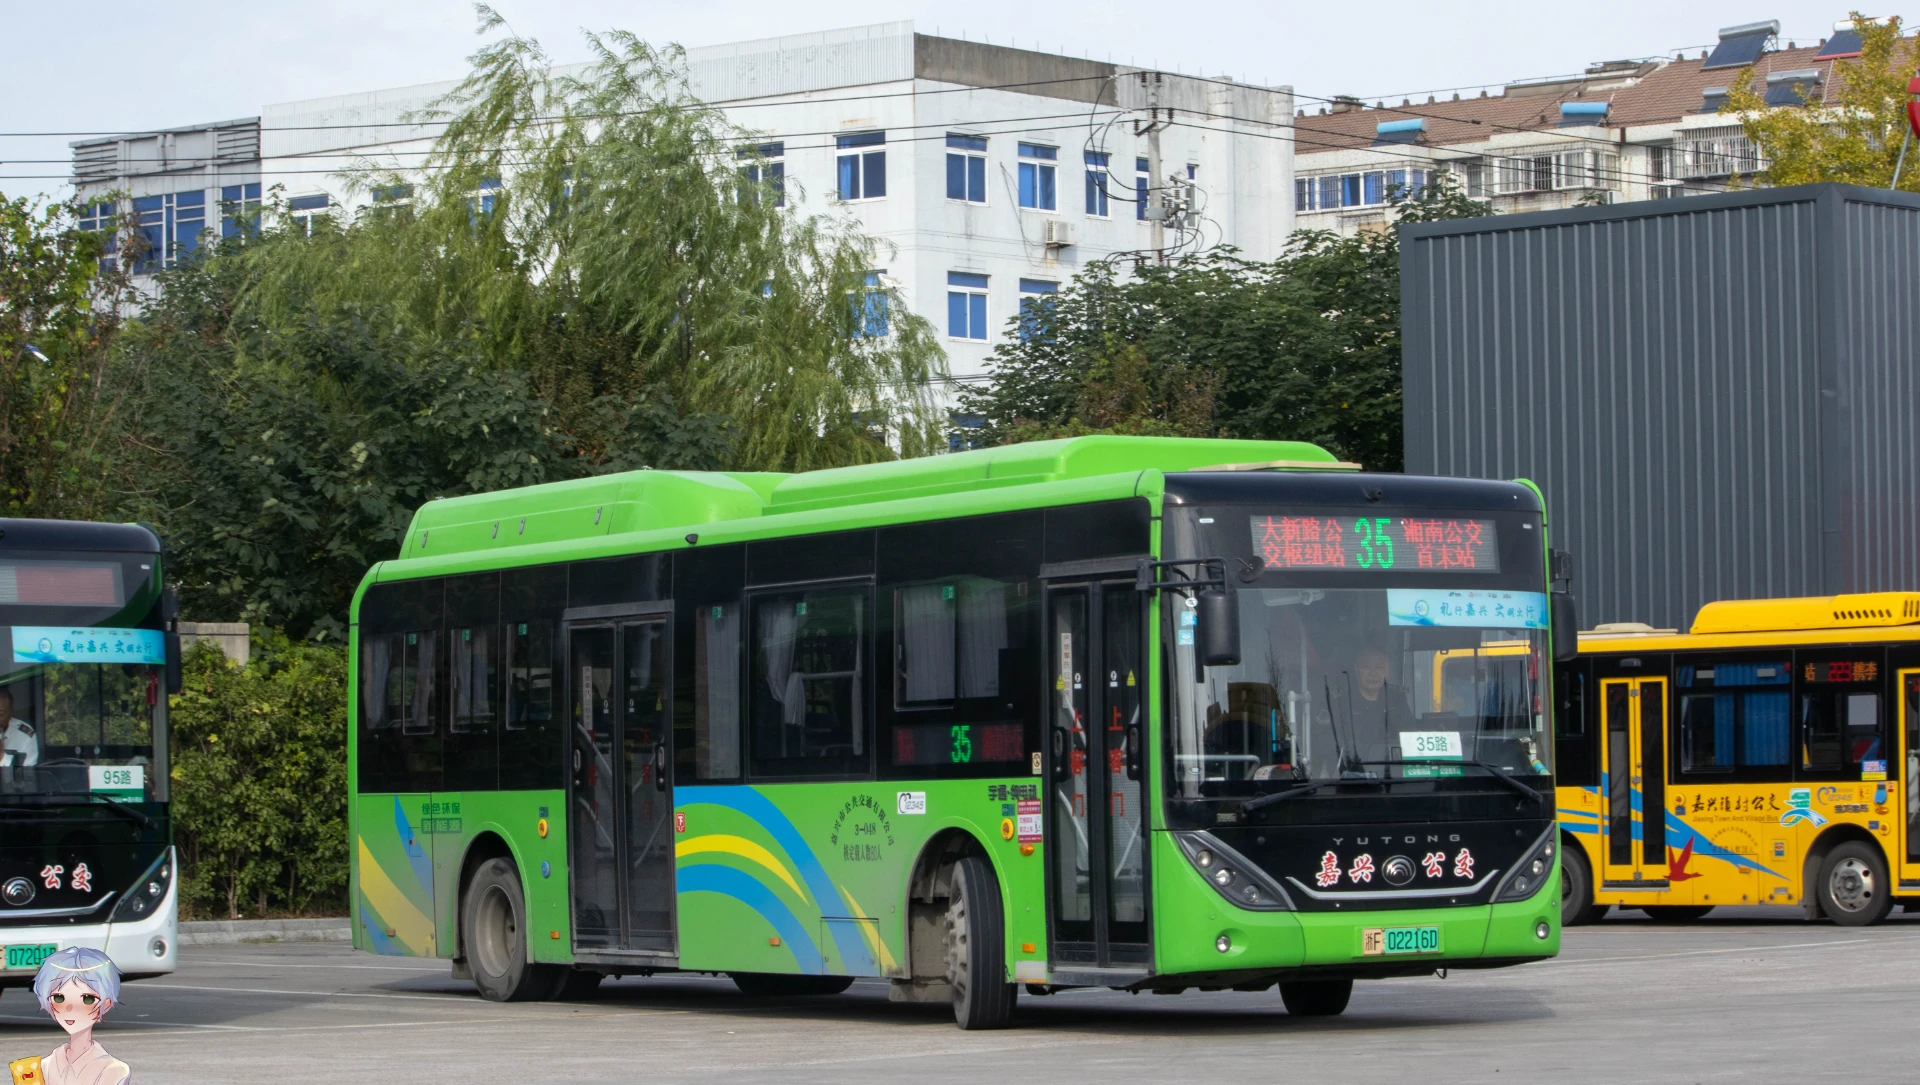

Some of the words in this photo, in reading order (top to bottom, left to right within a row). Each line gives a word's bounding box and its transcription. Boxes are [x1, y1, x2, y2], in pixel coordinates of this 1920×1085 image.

[1259, 516, 1343, 543] 大新路公
[1403, 518, 1483, 546] 湘南公交
[1263, 542, 1345, 569] 交枢纽站
[1354, 517, 1394, 569] 35
[1417, 543, 1476, 569] 首末站
[951, 725, 971, 763] 35
[1416, 736, 1448, 752] 35路
[103, 770, 131, 785] 95路
[422, 802, 461, 815] 绿色环保
[904, 800, 924, 810] 12345
[855, 822, 877, 836] 3-048
[1333, 834, 1461, 846] YUTONG
[40, 862, 92, 892] 公交
[1316, 850, 1375, 887] 嘉兴
[1422, 848, 1474, 880] 公交
[1365, 931, 1381, 952] 浙F
[1388, 930, 1438, 951] 02216D
